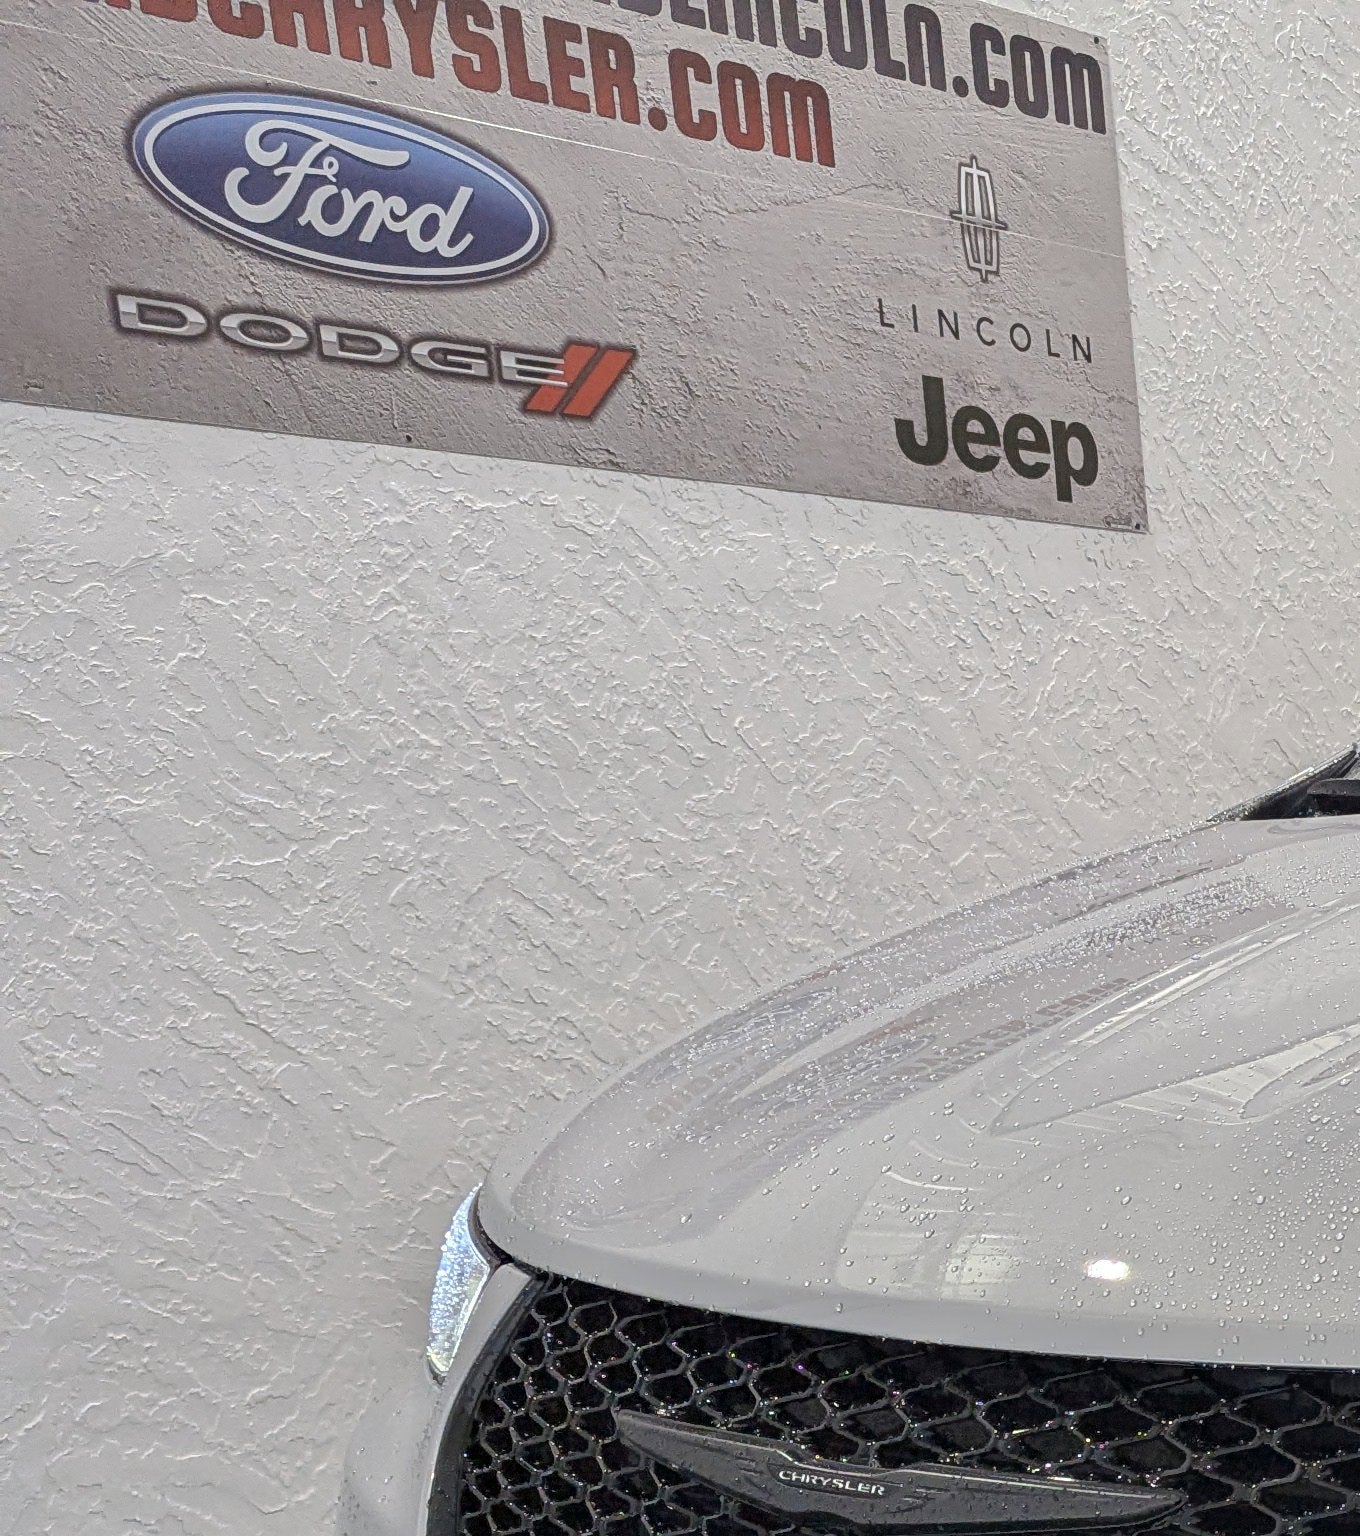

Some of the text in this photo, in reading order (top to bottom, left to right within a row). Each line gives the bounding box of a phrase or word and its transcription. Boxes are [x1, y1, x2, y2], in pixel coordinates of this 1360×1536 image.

[224, 119, 474, 258] Ford
[116, 294, 569, 389] DODGE
[877, 298, 1092, 363] LINCOLN
[894, 374, 1098, 503] Jeep
[778, 1470, 885, 1496] CHRYSLER
